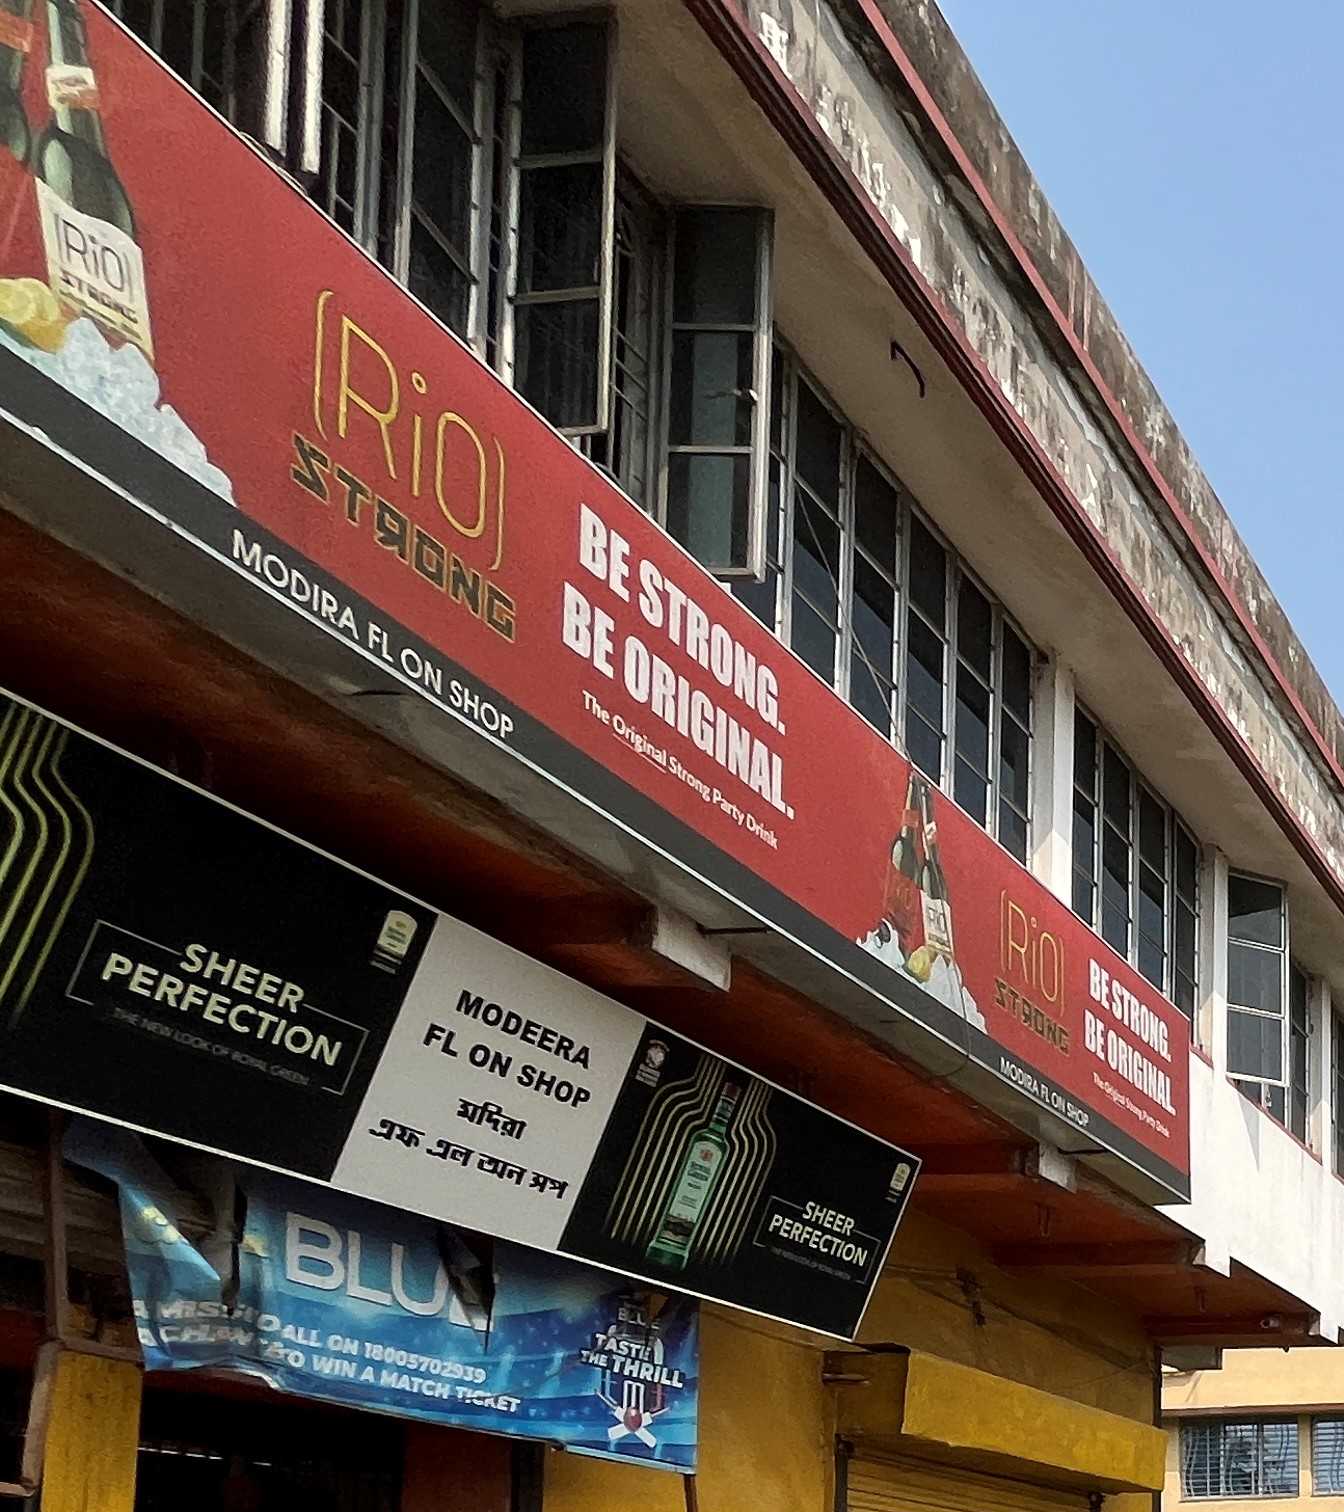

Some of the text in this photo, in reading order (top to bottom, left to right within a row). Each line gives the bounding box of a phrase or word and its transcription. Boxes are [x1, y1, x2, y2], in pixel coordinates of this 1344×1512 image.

[290, 428, 516, 643] STRONG
[232, 529, 514, 739] MODIRA FL ON SHOP
[579, 503, 787, 736] BE STRONG.
[562, 581, 796, 821] BE ORIGINAL.
[582, 689, 780, 850] The Original Strong Party Drink
[102, 952, 343, 1066] PERFECTION
[180, 943, 305, 1014] SHEER
[993, 975, 1071, 1058] STRONG
[1089, 958, 1172, 1063] BE STRONG.
[422, 1022, 458, 1058] FL
[469, 1044, 512, 1078] ON
[517, 1064, 592, 1108] SHOP
[455, 989, 591, 1070] MODEERA
[1084, 1009, 1177, 1117] BE ORIGINAL.
[457, 1097, 528, 1140] মদিরা
[1000, 1056, 1038, 1095] MODIRA
[1051, 1092, 1066, 1112] ON
[1067, 1101, 1090, 1127] SHOP
[368, 1118, 426, 1148] এফ
[426, 1138, 475, 1167] এল
[768, 1213, 868, 1267] PERFECTION
[802, 1200, 855, 1237] SHEER
[311, 1354, 358, 1380] WIN
[359, 1363, 376, 1383] A
[380, 1368, 449, 1400] MATCH
[455, 1384, 522, 1415] TICKET
[327, 1333, 360, 1357] ON
[581, 1349, 684, 1389] THE THRILL
